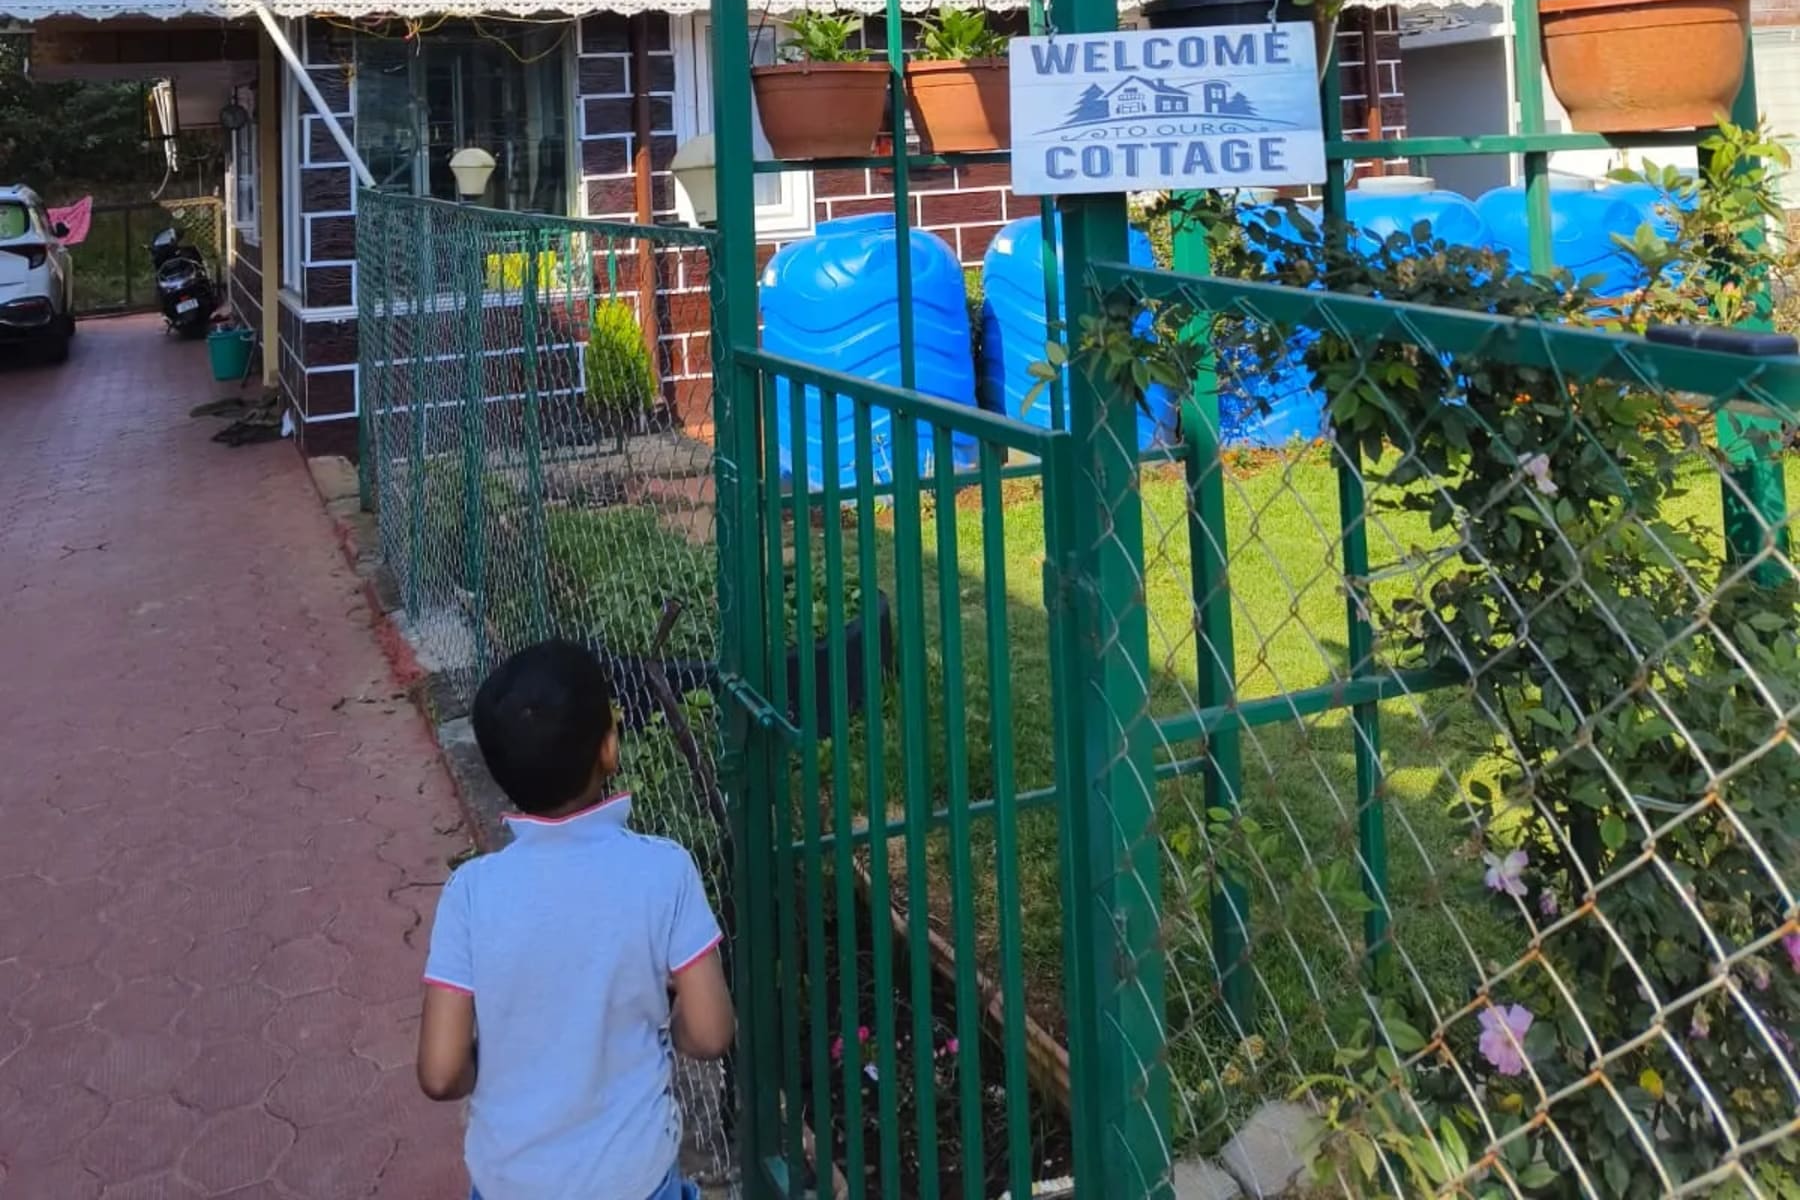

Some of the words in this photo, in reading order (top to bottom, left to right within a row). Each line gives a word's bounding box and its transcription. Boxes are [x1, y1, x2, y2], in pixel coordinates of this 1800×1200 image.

[1031, 31, 1292, 76] WELCOME
[1109, 125, 1147, 137] TO
[1157, 122, 1216, 136] OUR
[1045, 137, 1287, 180] COTTAGE
